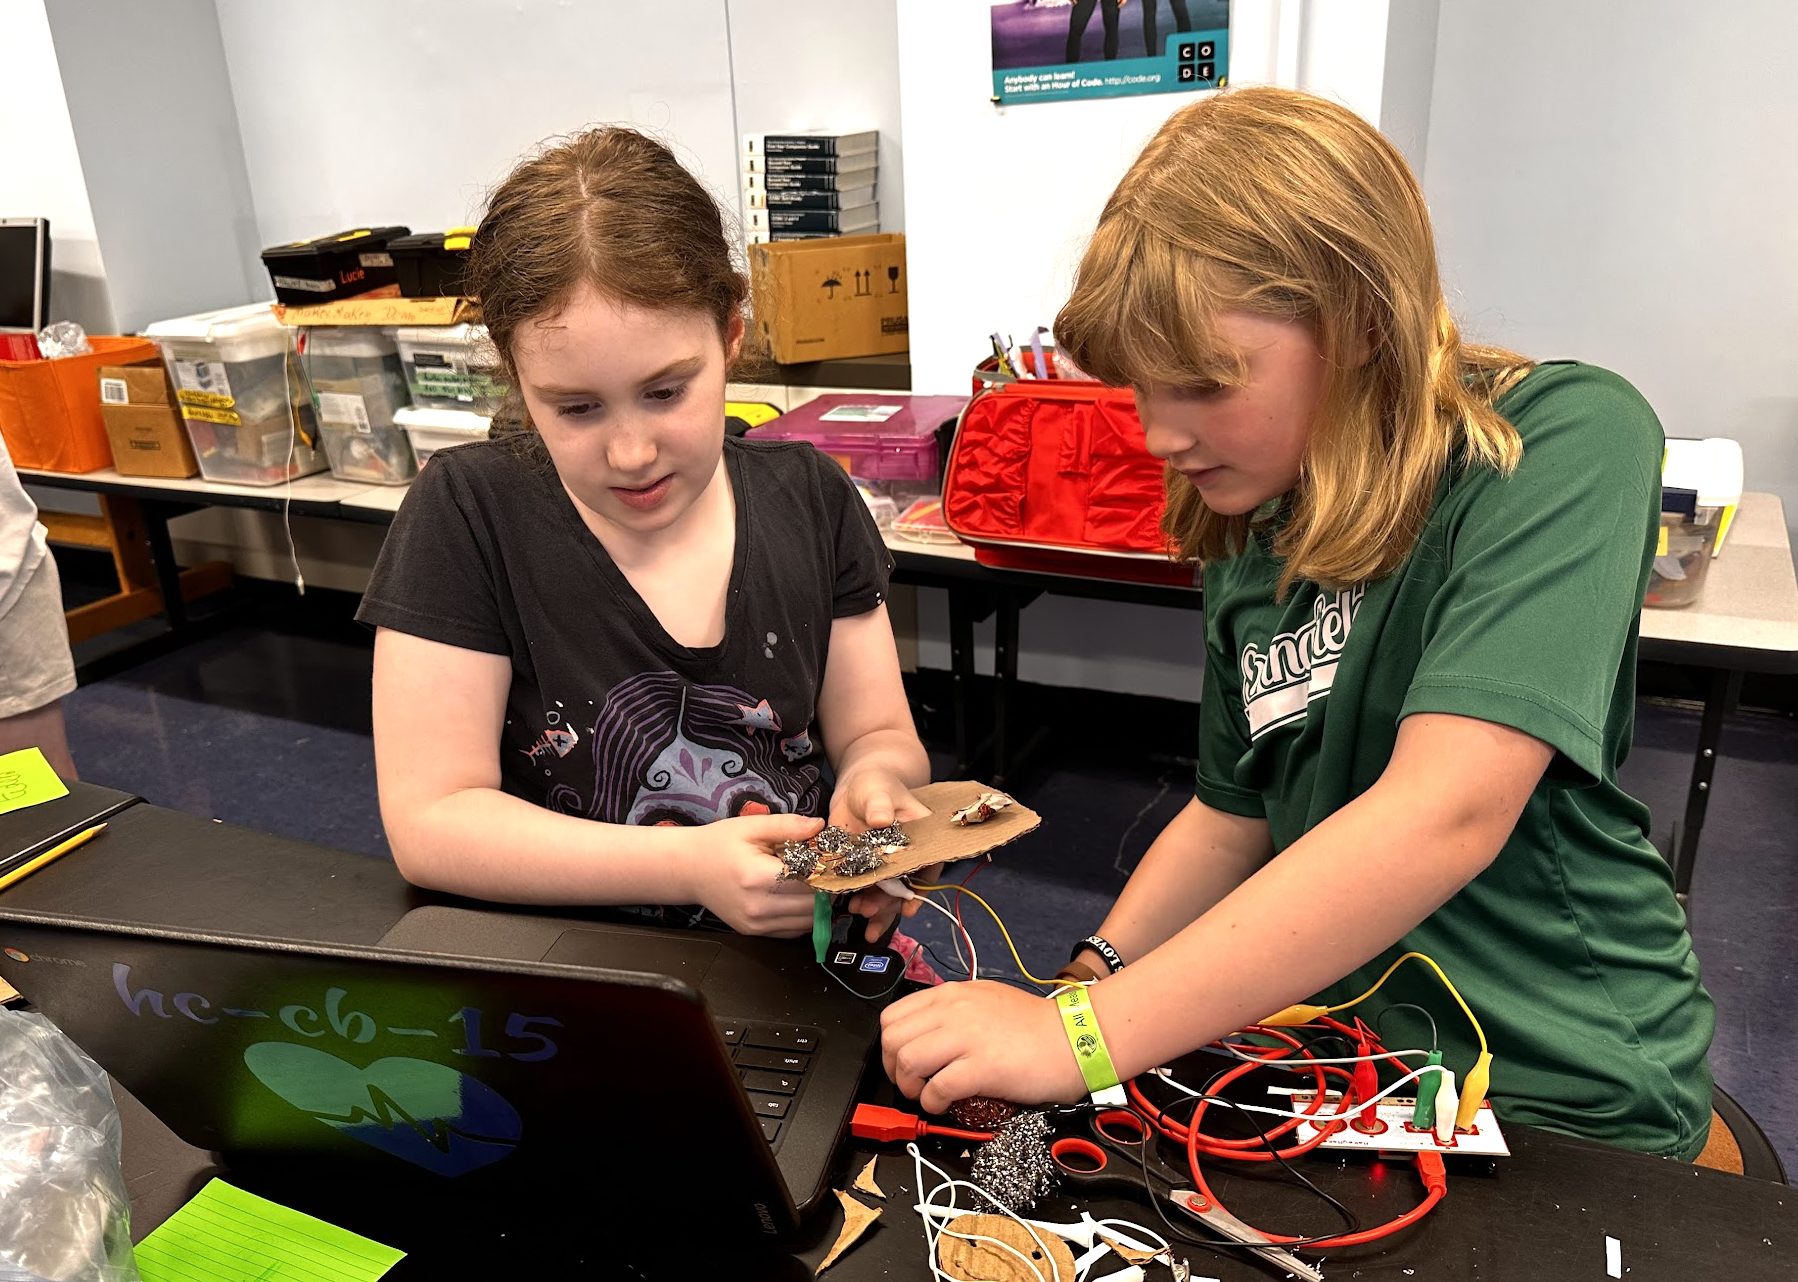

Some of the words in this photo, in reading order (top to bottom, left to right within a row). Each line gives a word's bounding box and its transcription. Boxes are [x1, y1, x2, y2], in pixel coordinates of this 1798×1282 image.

[1004, 75, 1037, 85] Anybody
[1039, 73, 1052, 81] can
[1054, 71, 1075, 80] learn!
[1004, 84, 1023, 93] Start
[1024, 82, 1040, 92] with
[1041, 83, 1051, 91] an
[1052, 80, 1071, 90] Hour
[1071, 79, 1080, 88] of
[339, 267, 365, 285] Lucie
[29, 952, 88, 968] chrome
[112, 962, 565, 1062] hc-cb-15
[1073, 1013, 1087, 1026] All
[753, 1202, 778, 1235] Lenovo
